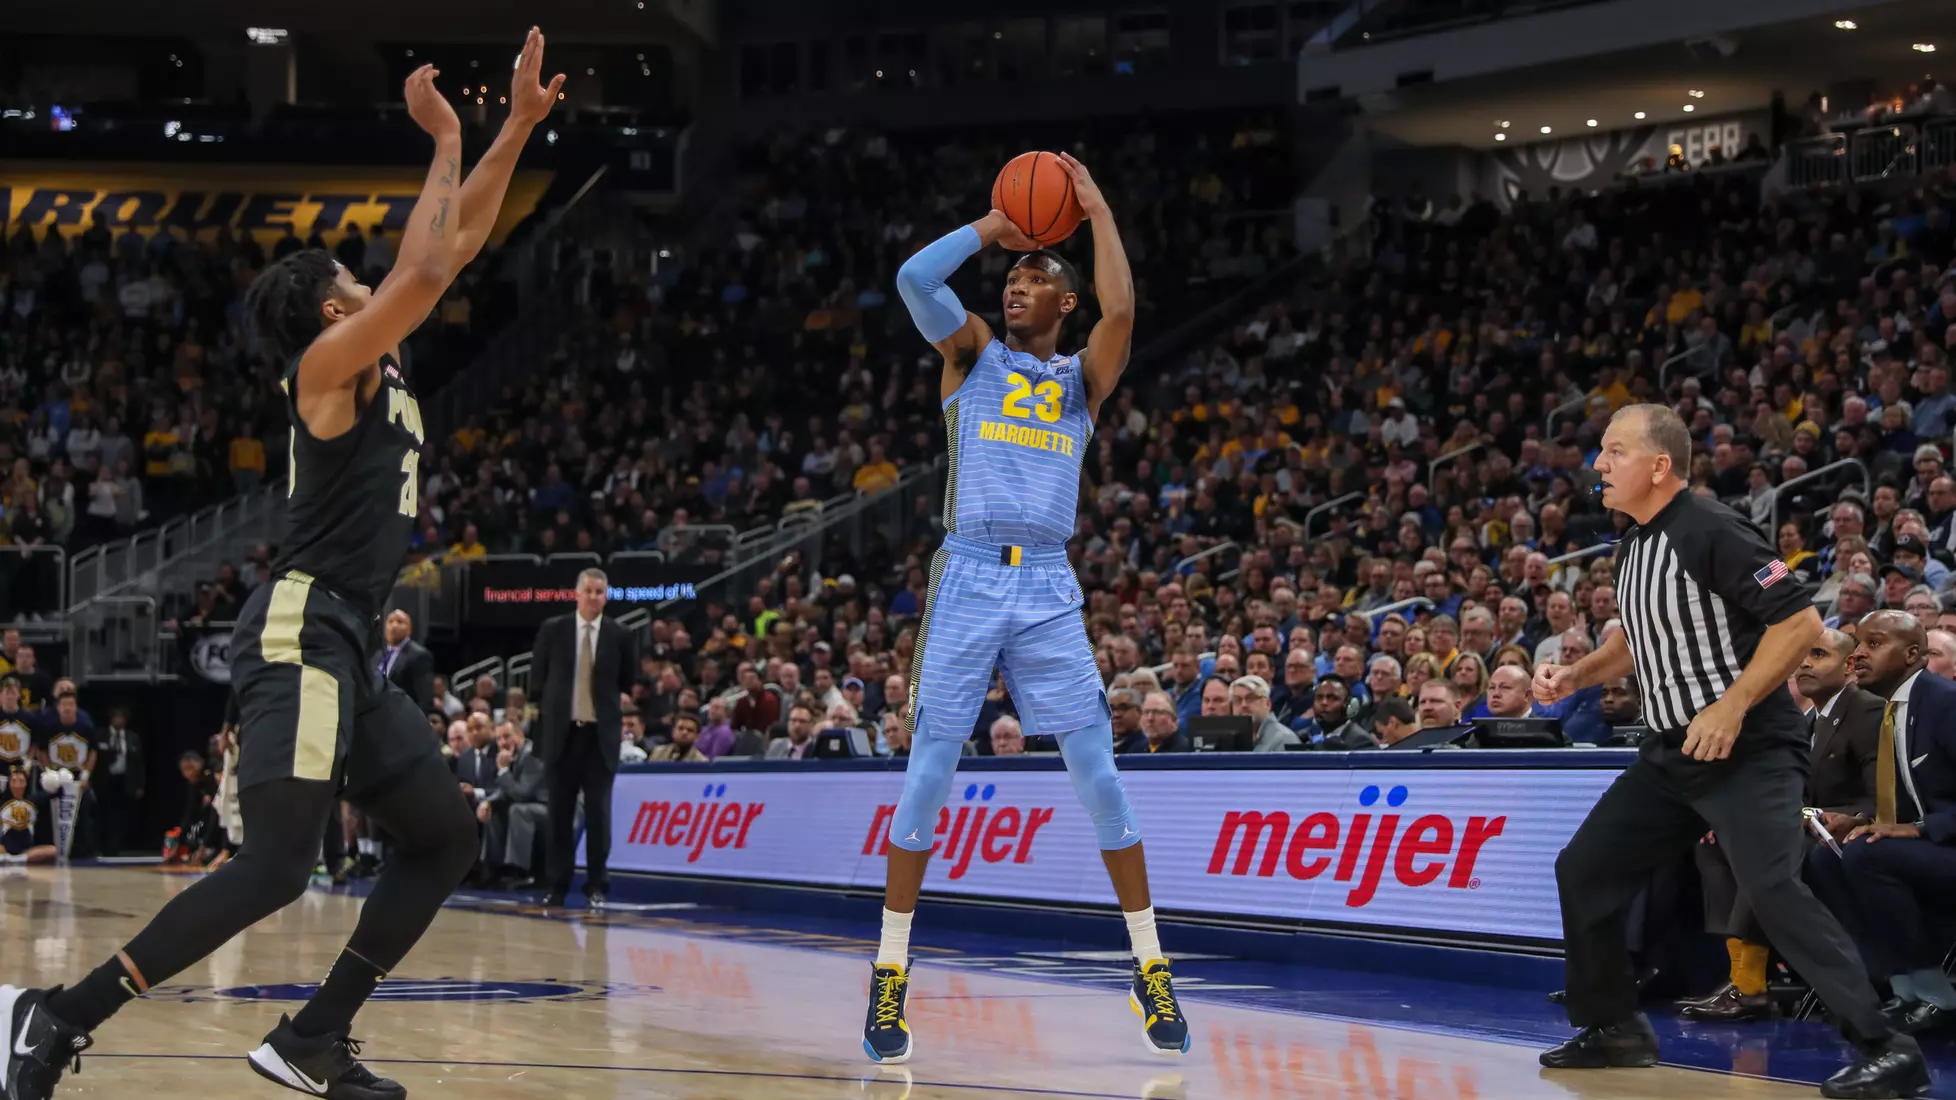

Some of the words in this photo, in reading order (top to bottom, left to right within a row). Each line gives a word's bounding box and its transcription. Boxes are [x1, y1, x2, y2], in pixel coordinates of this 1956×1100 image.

[1002, 372, 1063, 423] 23
[980, 421, 1073, 457] MARQUETTE
[627, 784, 766, 864] meijer
[1206, 785, 1507, 908] meijer
